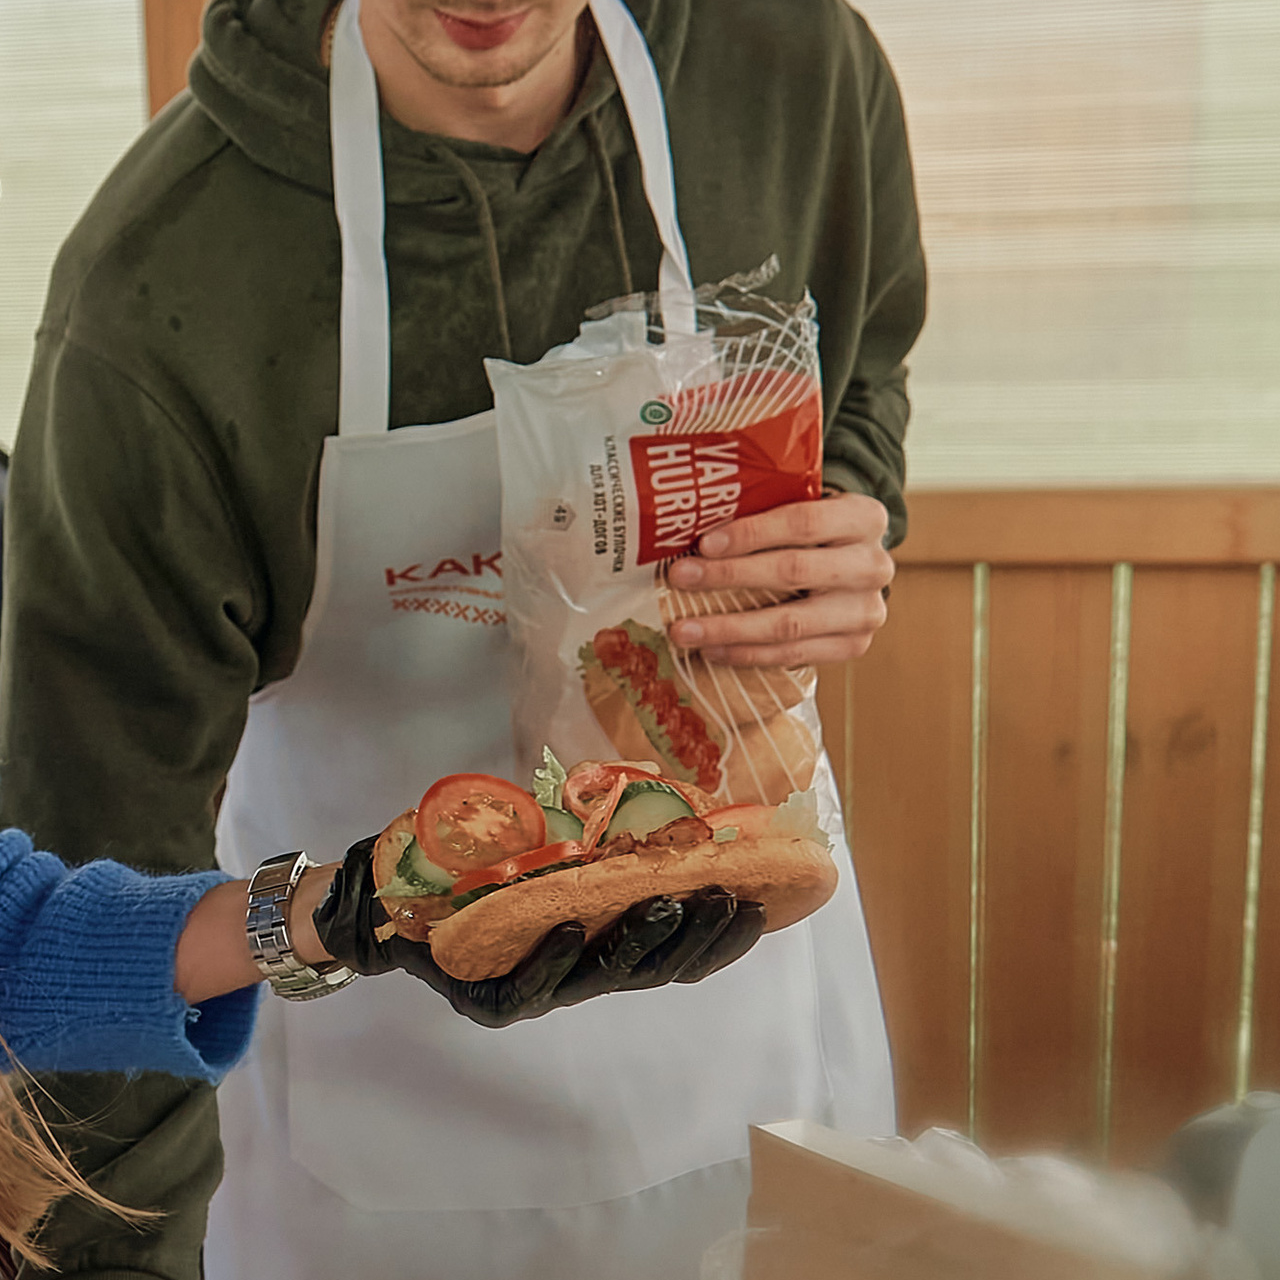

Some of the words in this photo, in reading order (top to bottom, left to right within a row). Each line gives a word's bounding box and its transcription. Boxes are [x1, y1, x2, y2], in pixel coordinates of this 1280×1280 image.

[590, 464, 605, 489] ДЛЯ
[647, 443, 696, 548] HURRY
[593, 491, 608, 555] ХОТ-ДОГОВ
